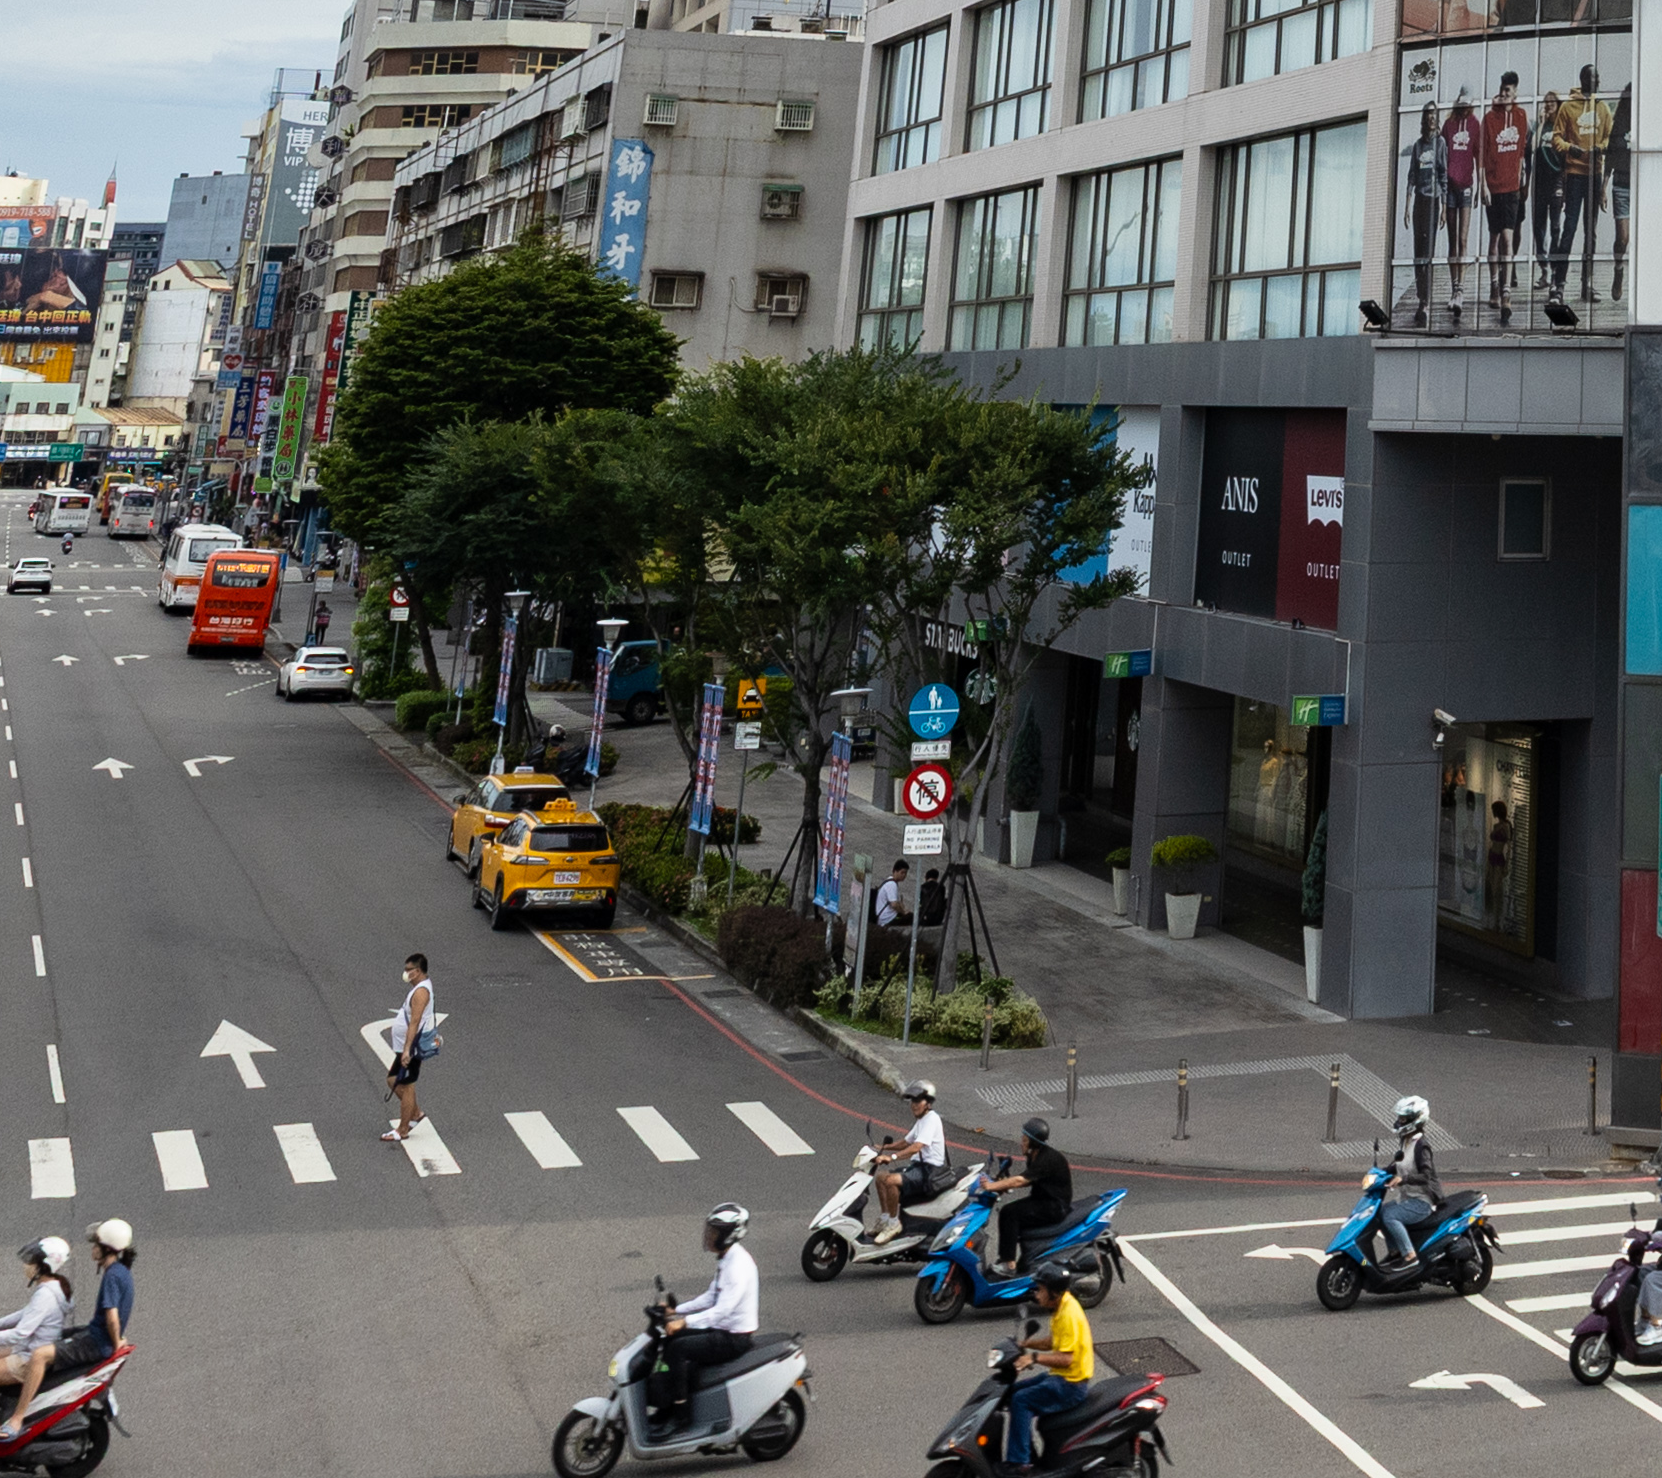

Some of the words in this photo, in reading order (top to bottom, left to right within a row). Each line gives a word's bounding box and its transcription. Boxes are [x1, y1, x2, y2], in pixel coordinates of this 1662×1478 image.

[1410, 82, 1434, 94] Roots
[606, 148, 648, 285] 錦和牙
[1220, 476, 1259, 514] ANIS
[1222, 550, 1252, 567] OUTLET
[1306, 561, 1340, 579] OUTLET
[914, 744, 949, 755] 行人優先
[916, 779, 939, 806] 停
